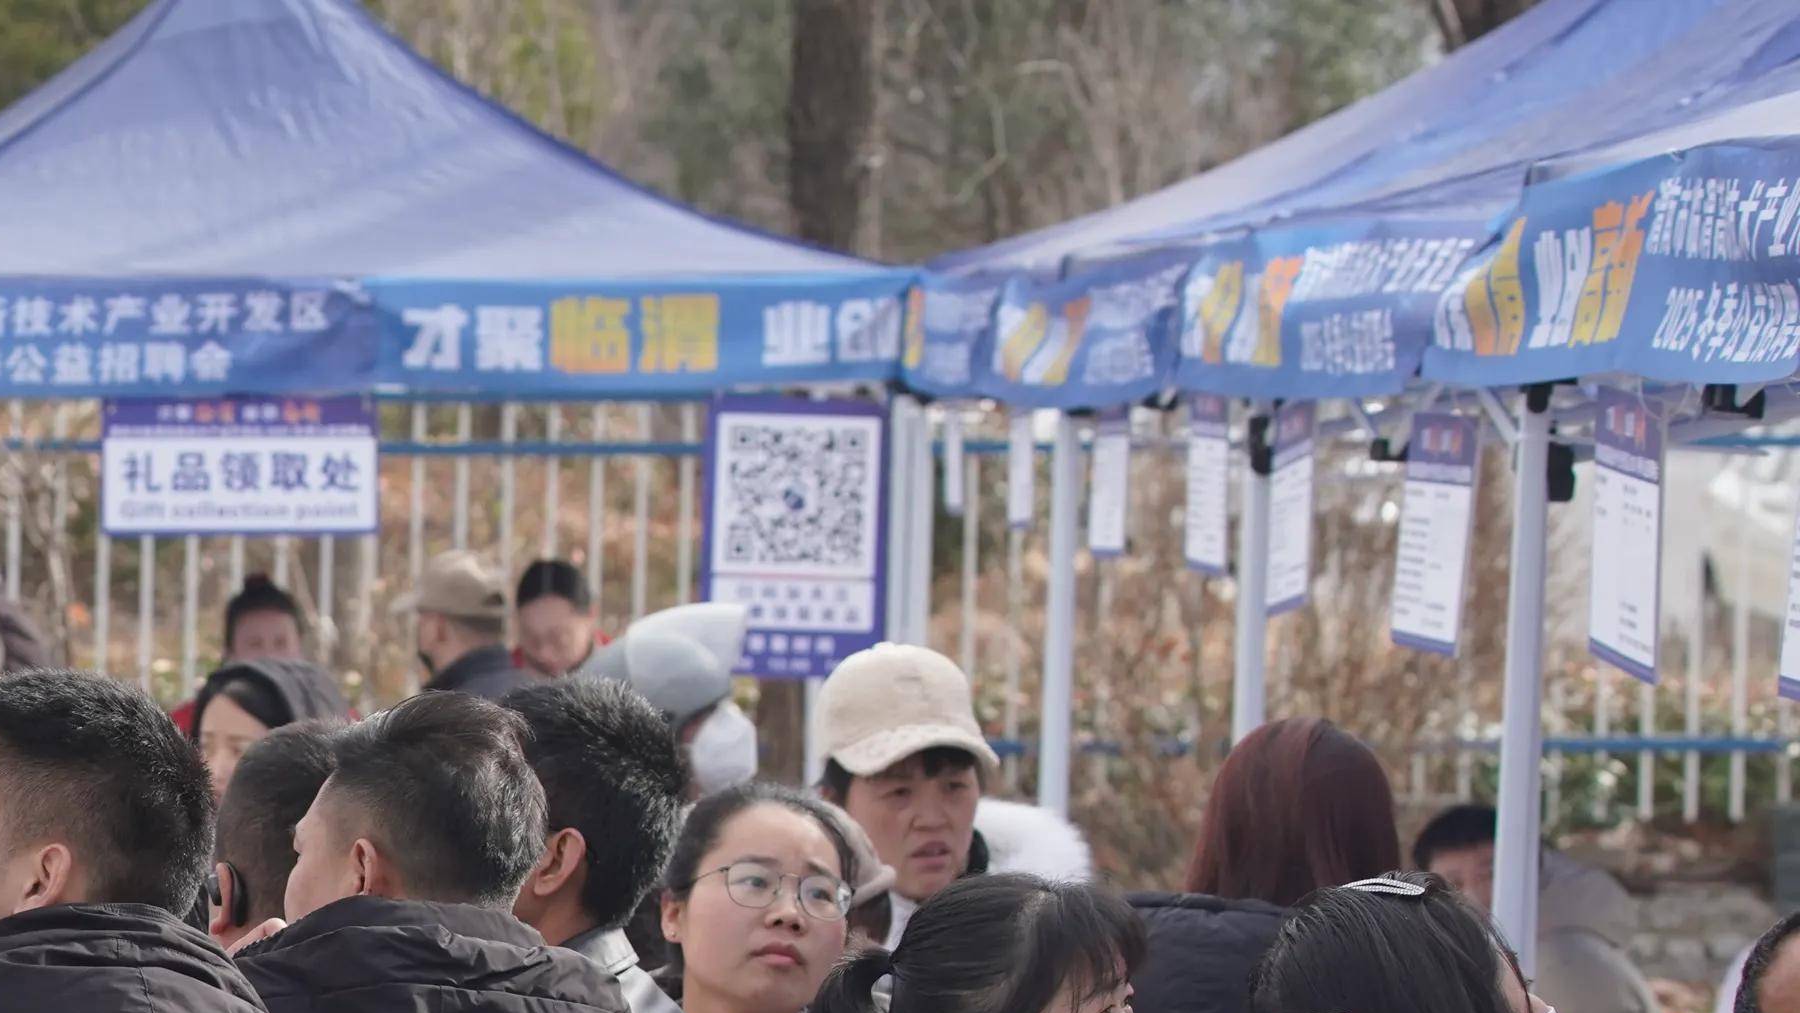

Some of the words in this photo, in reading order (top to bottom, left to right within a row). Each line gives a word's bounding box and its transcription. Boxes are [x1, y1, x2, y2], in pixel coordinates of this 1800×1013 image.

[401, 292, 720, 375] 才聚临渭
[121, 451, 360, 492] 礼品领取处
[119, 501, 165, 520] Gift
[171, 501, 291, 520] collection
[296, 501, 360, 524] point
